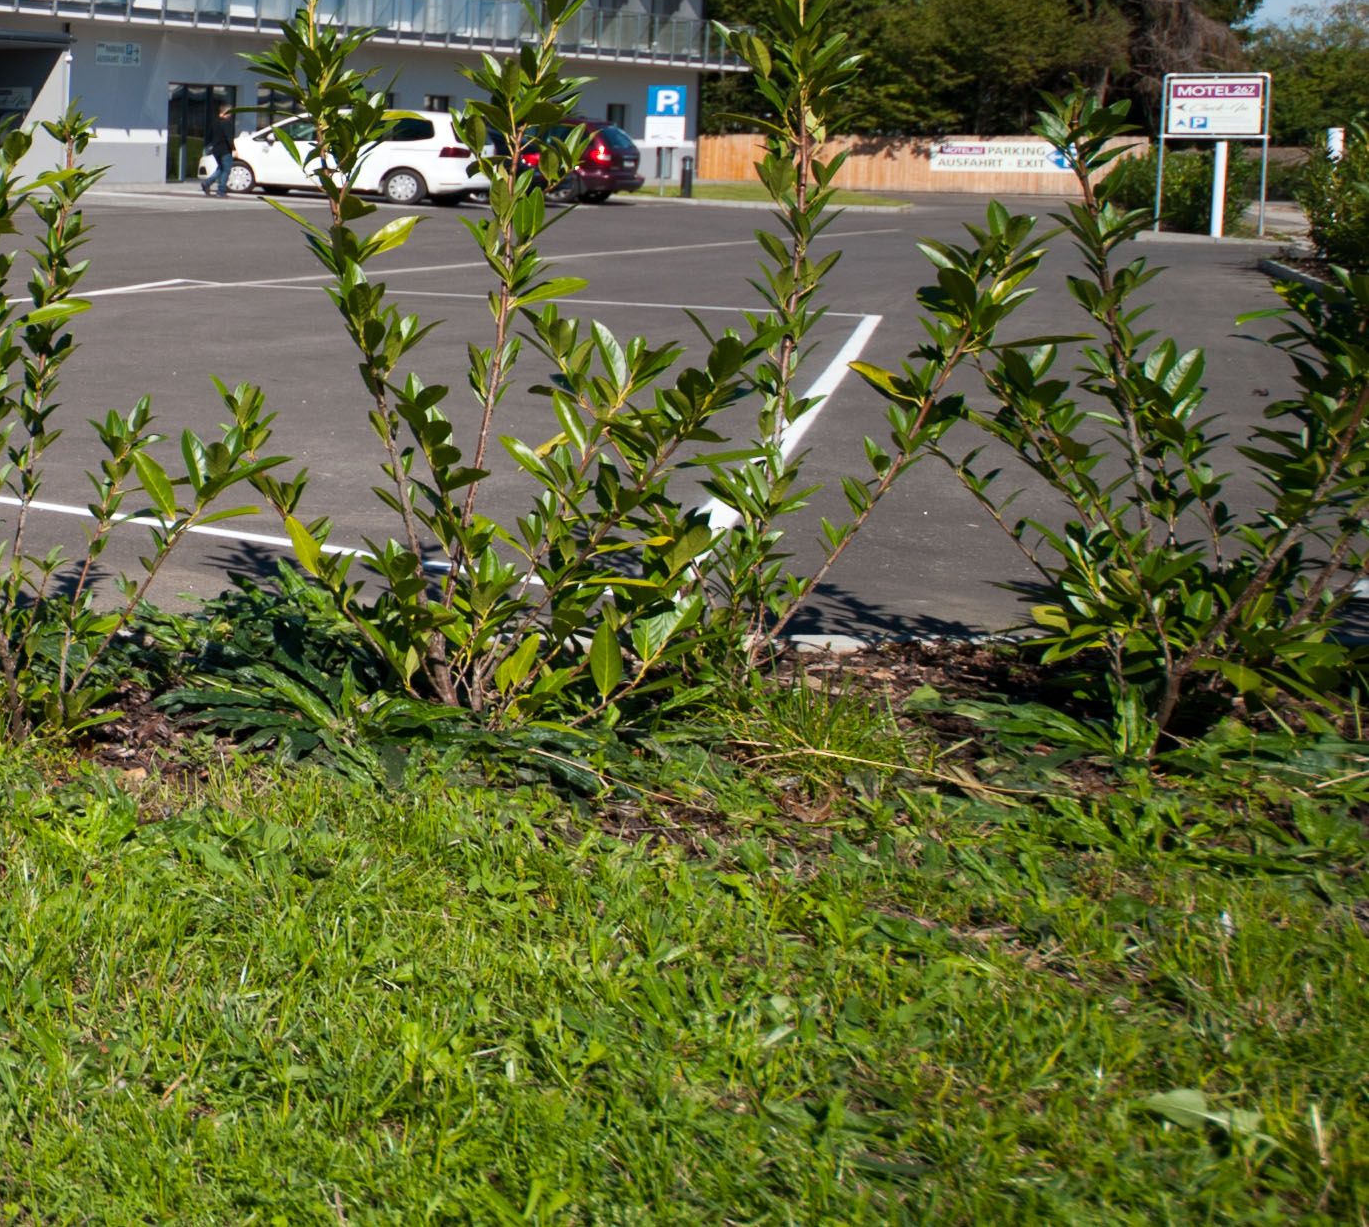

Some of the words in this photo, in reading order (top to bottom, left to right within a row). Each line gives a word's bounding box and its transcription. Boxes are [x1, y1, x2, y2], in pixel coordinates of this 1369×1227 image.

[988, 146, 1046, 156] PARKING
[937, 157, 1003, 168] AUSFAHRT
[1017, 158, 1046, 169] EXIT
